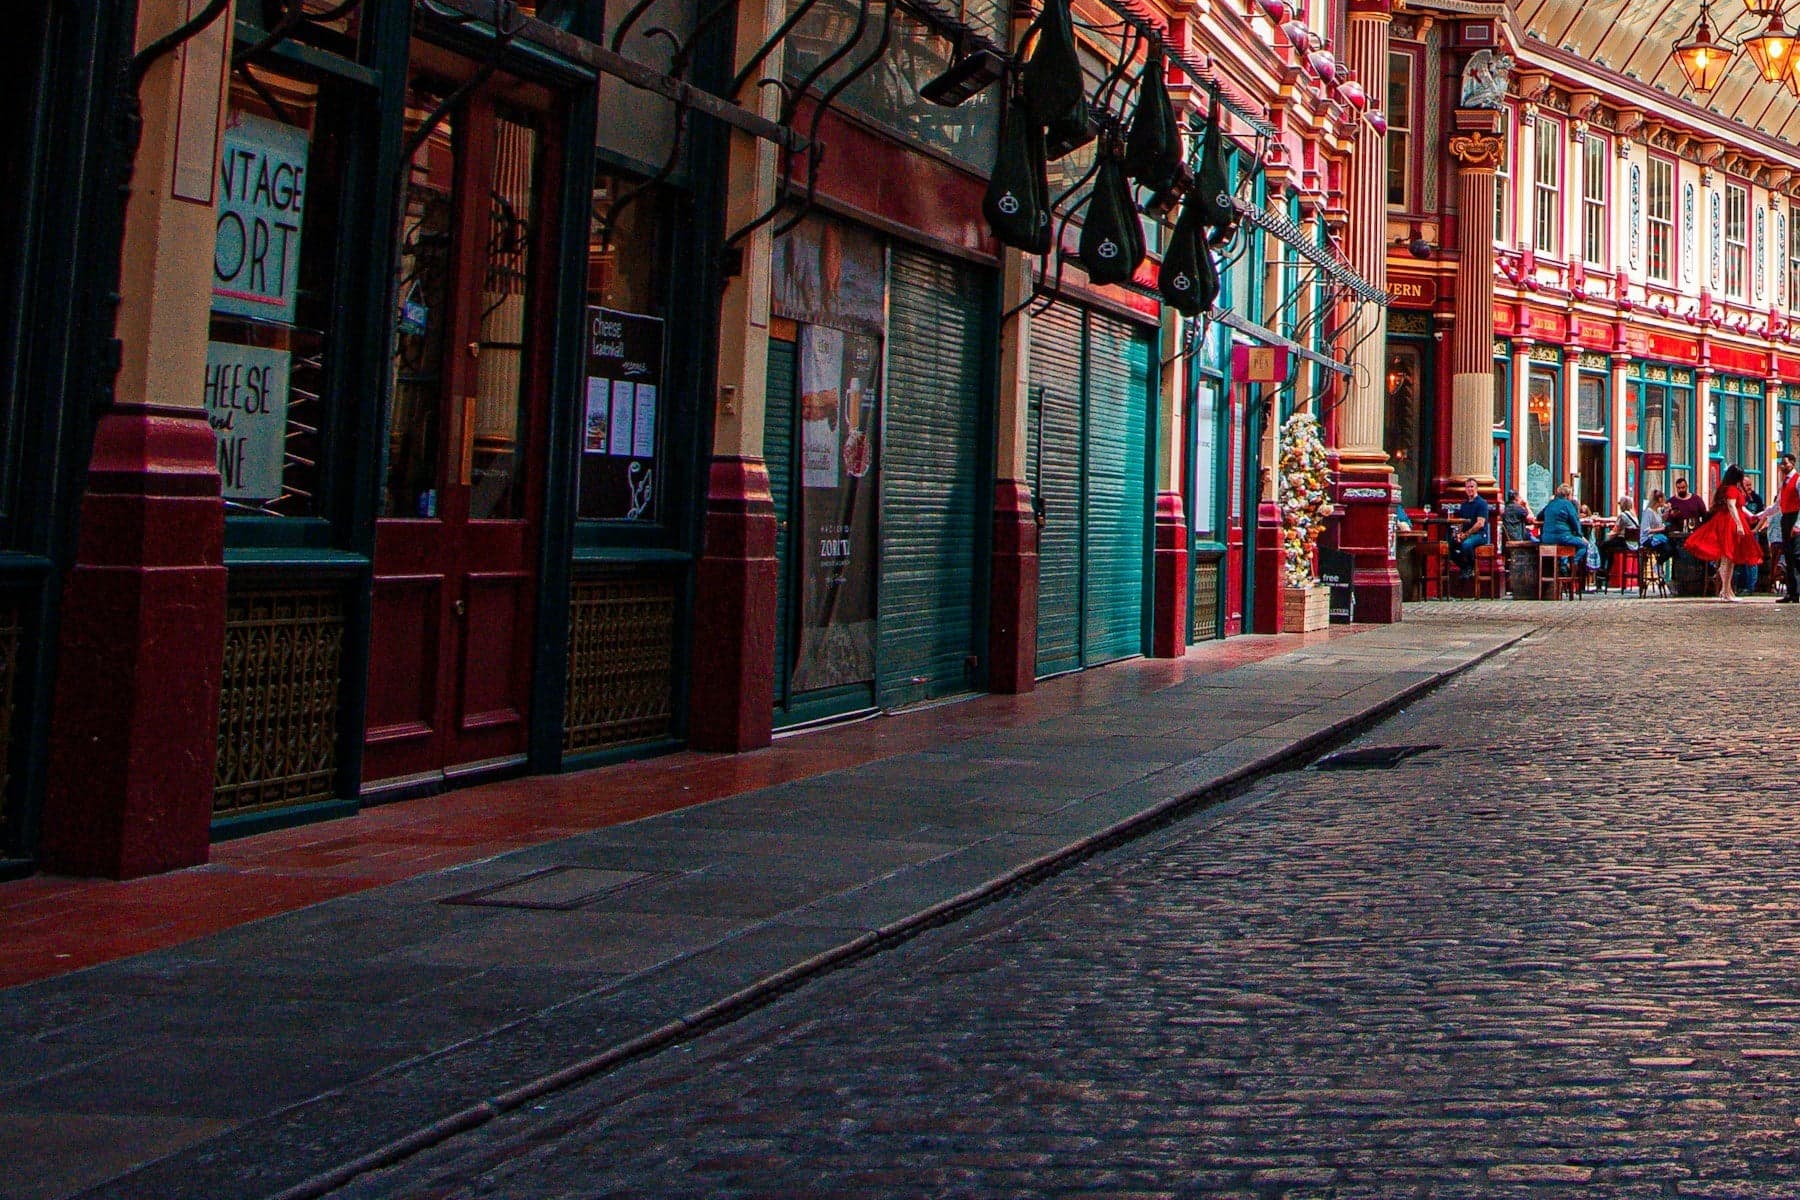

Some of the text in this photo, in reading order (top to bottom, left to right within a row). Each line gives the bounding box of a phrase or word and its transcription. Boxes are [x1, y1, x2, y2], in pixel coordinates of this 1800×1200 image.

[214, 211, 298, 296] ORT
[204, 364, 272, 414] HEESE
[1322, 573, 1340, 583] free
